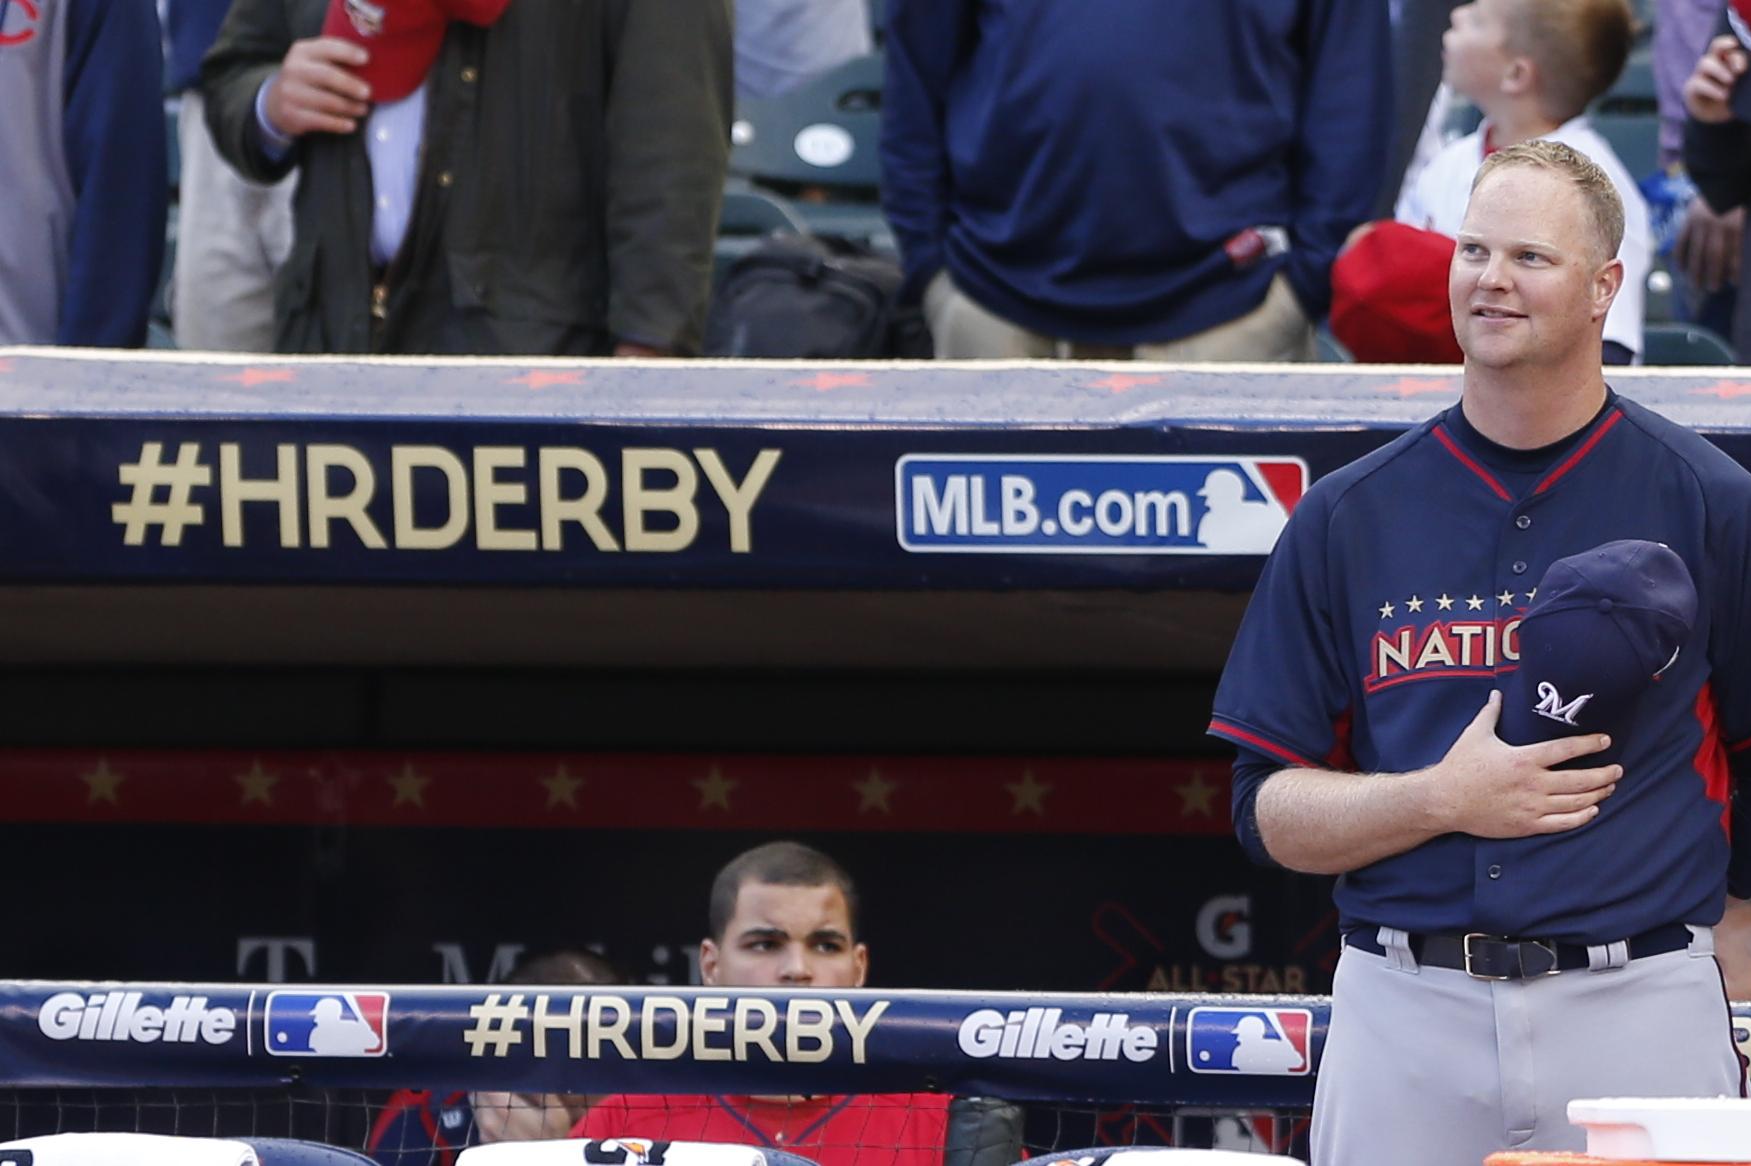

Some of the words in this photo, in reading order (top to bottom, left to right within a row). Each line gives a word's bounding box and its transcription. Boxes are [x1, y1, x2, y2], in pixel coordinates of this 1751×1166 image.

[112, 441, 782, 553] #HRDERBY
[911, 474, 1191, 537] MLB.com
[1378, 620, 1521, 678] NATIO
[38, 991, 236, 1045] Gillette
[463, 993, 890, 1064] #HRDERBY
[958, 1007, 1158, 1062] Gillette
